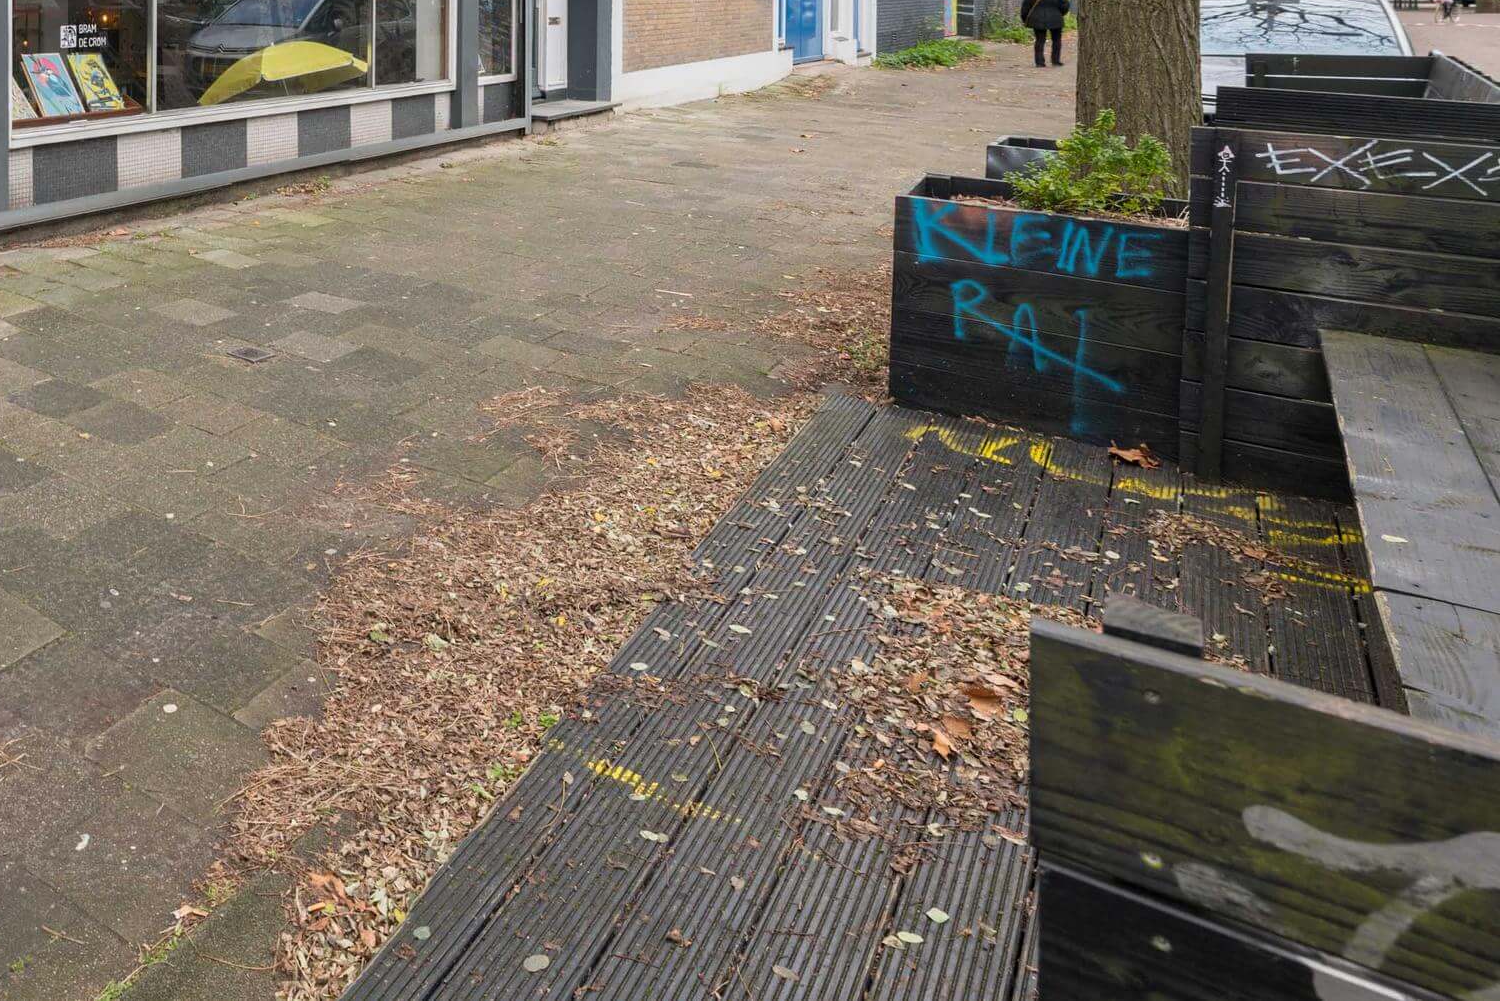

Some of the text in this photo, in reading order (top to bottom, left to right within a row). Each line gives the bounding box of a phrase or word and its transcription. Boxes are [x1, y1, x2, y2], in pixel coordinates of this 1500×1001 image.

[78, 24, 97, 35] BRAM
[78, 35, 107, 48] DE CROM
